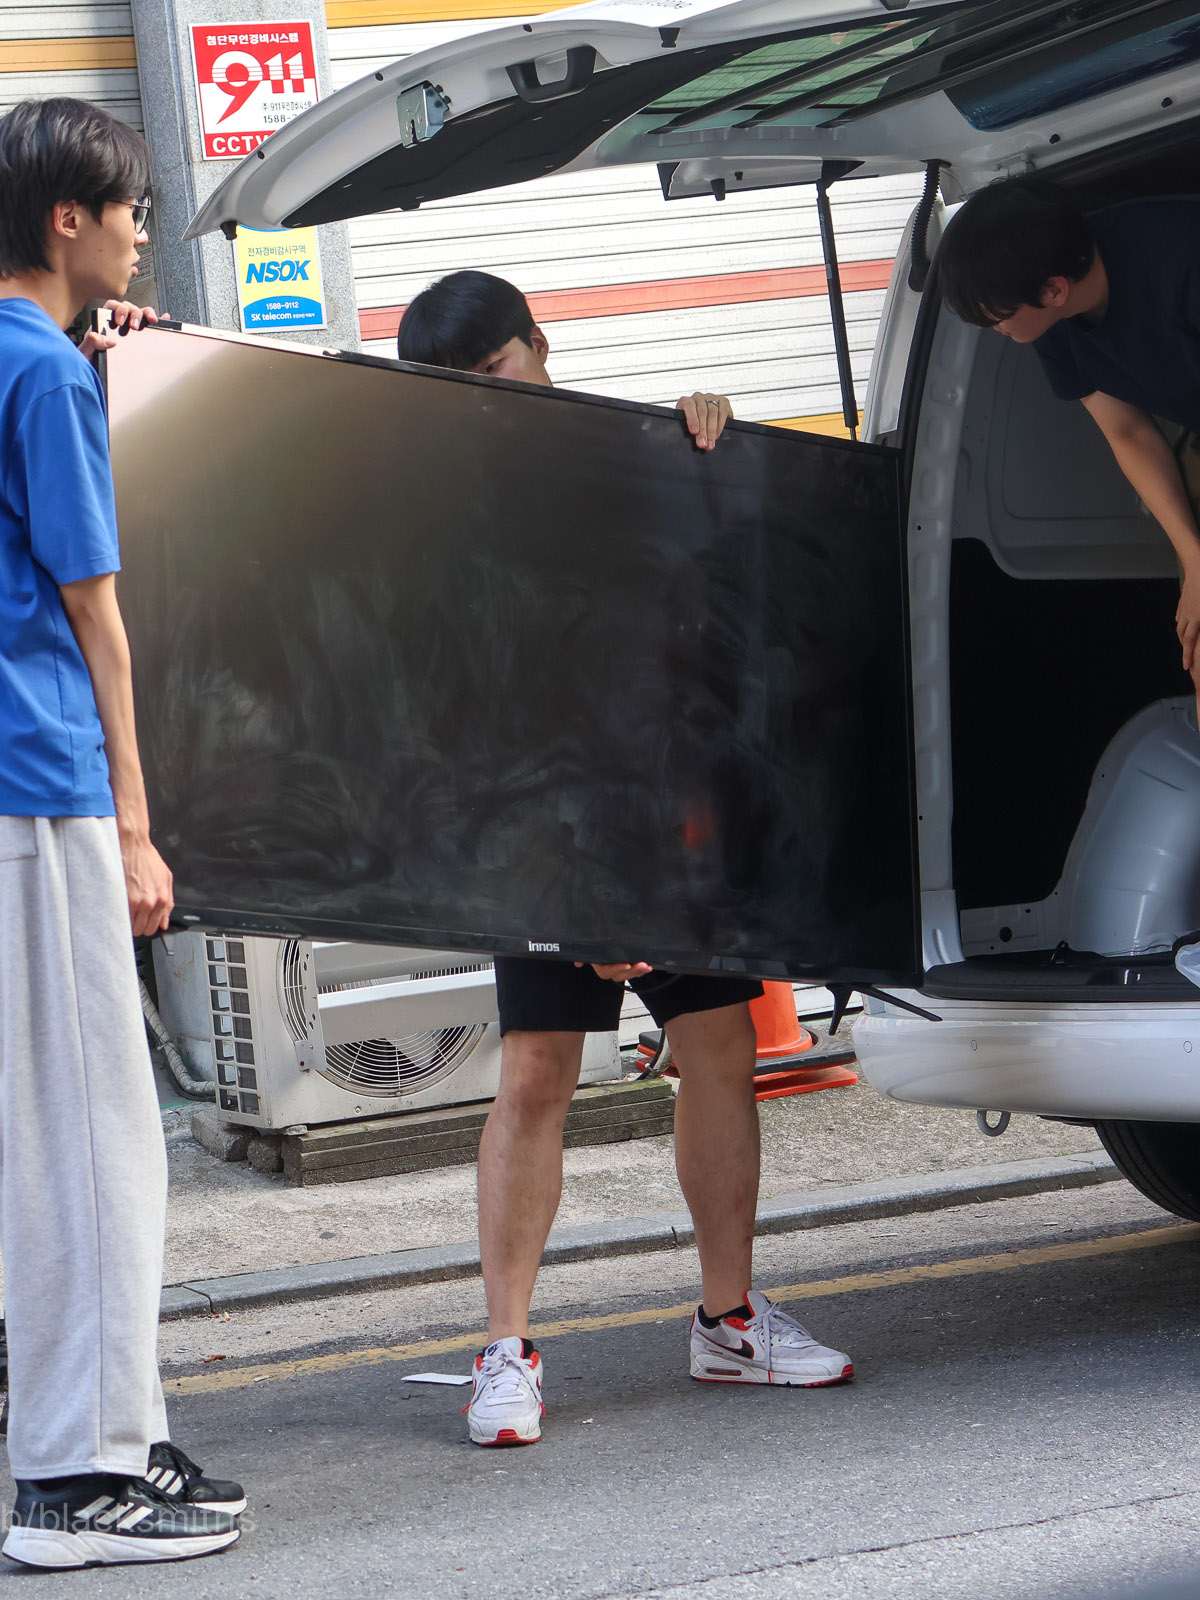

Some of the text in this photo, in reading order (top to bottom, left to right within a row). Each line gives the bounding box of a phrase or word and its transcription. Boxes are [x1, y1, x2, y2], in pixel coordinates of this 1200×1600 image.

[206, 32, 299, 46] 첨단무인경비시스템
[211, 50, 305, 126] 911
[263, 114, 298, 124] 1588-
[248, 244, 307, 257] 전자경비감시구역
[246, 260, 311, 284] NSOK
[266, 301, 299, 310] 1588-9112
[251, 313, 261, 321] SK
[262, 312, 292, 321] telecom
[528, 940, 560, 952] innos
